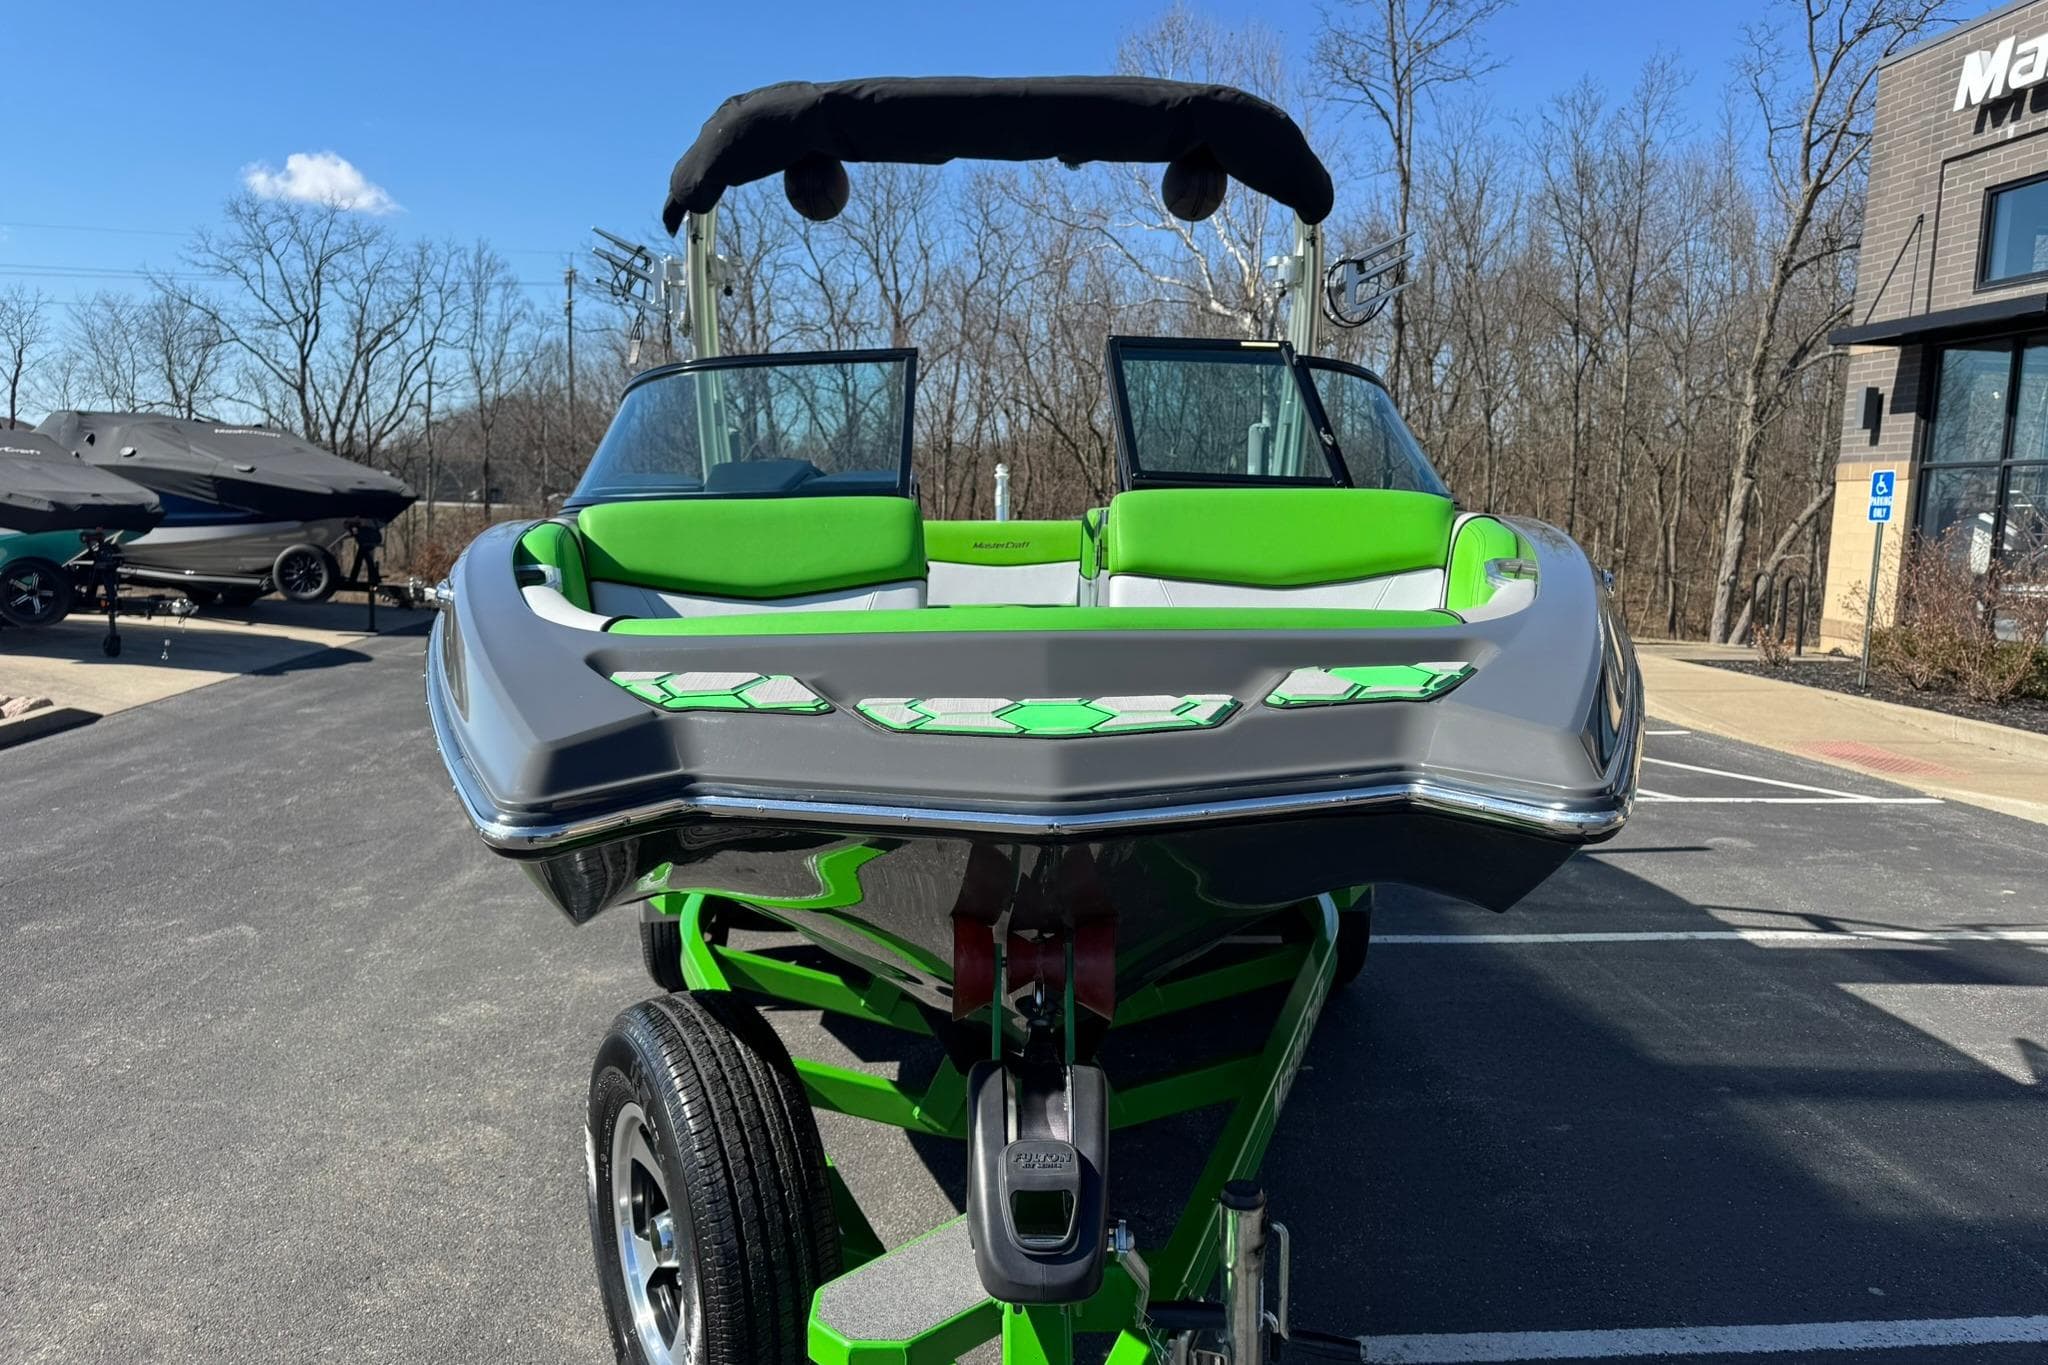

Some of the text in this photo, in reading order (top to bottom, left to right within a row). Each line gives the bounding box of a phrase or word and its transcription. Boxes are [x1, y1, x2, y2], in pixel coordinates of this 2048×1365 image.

[1953, 32, 2048, 112] Ma
[1873, 507, 1887, 518] ONLY
[1014, 1152, 1072, 1163] FULTON
